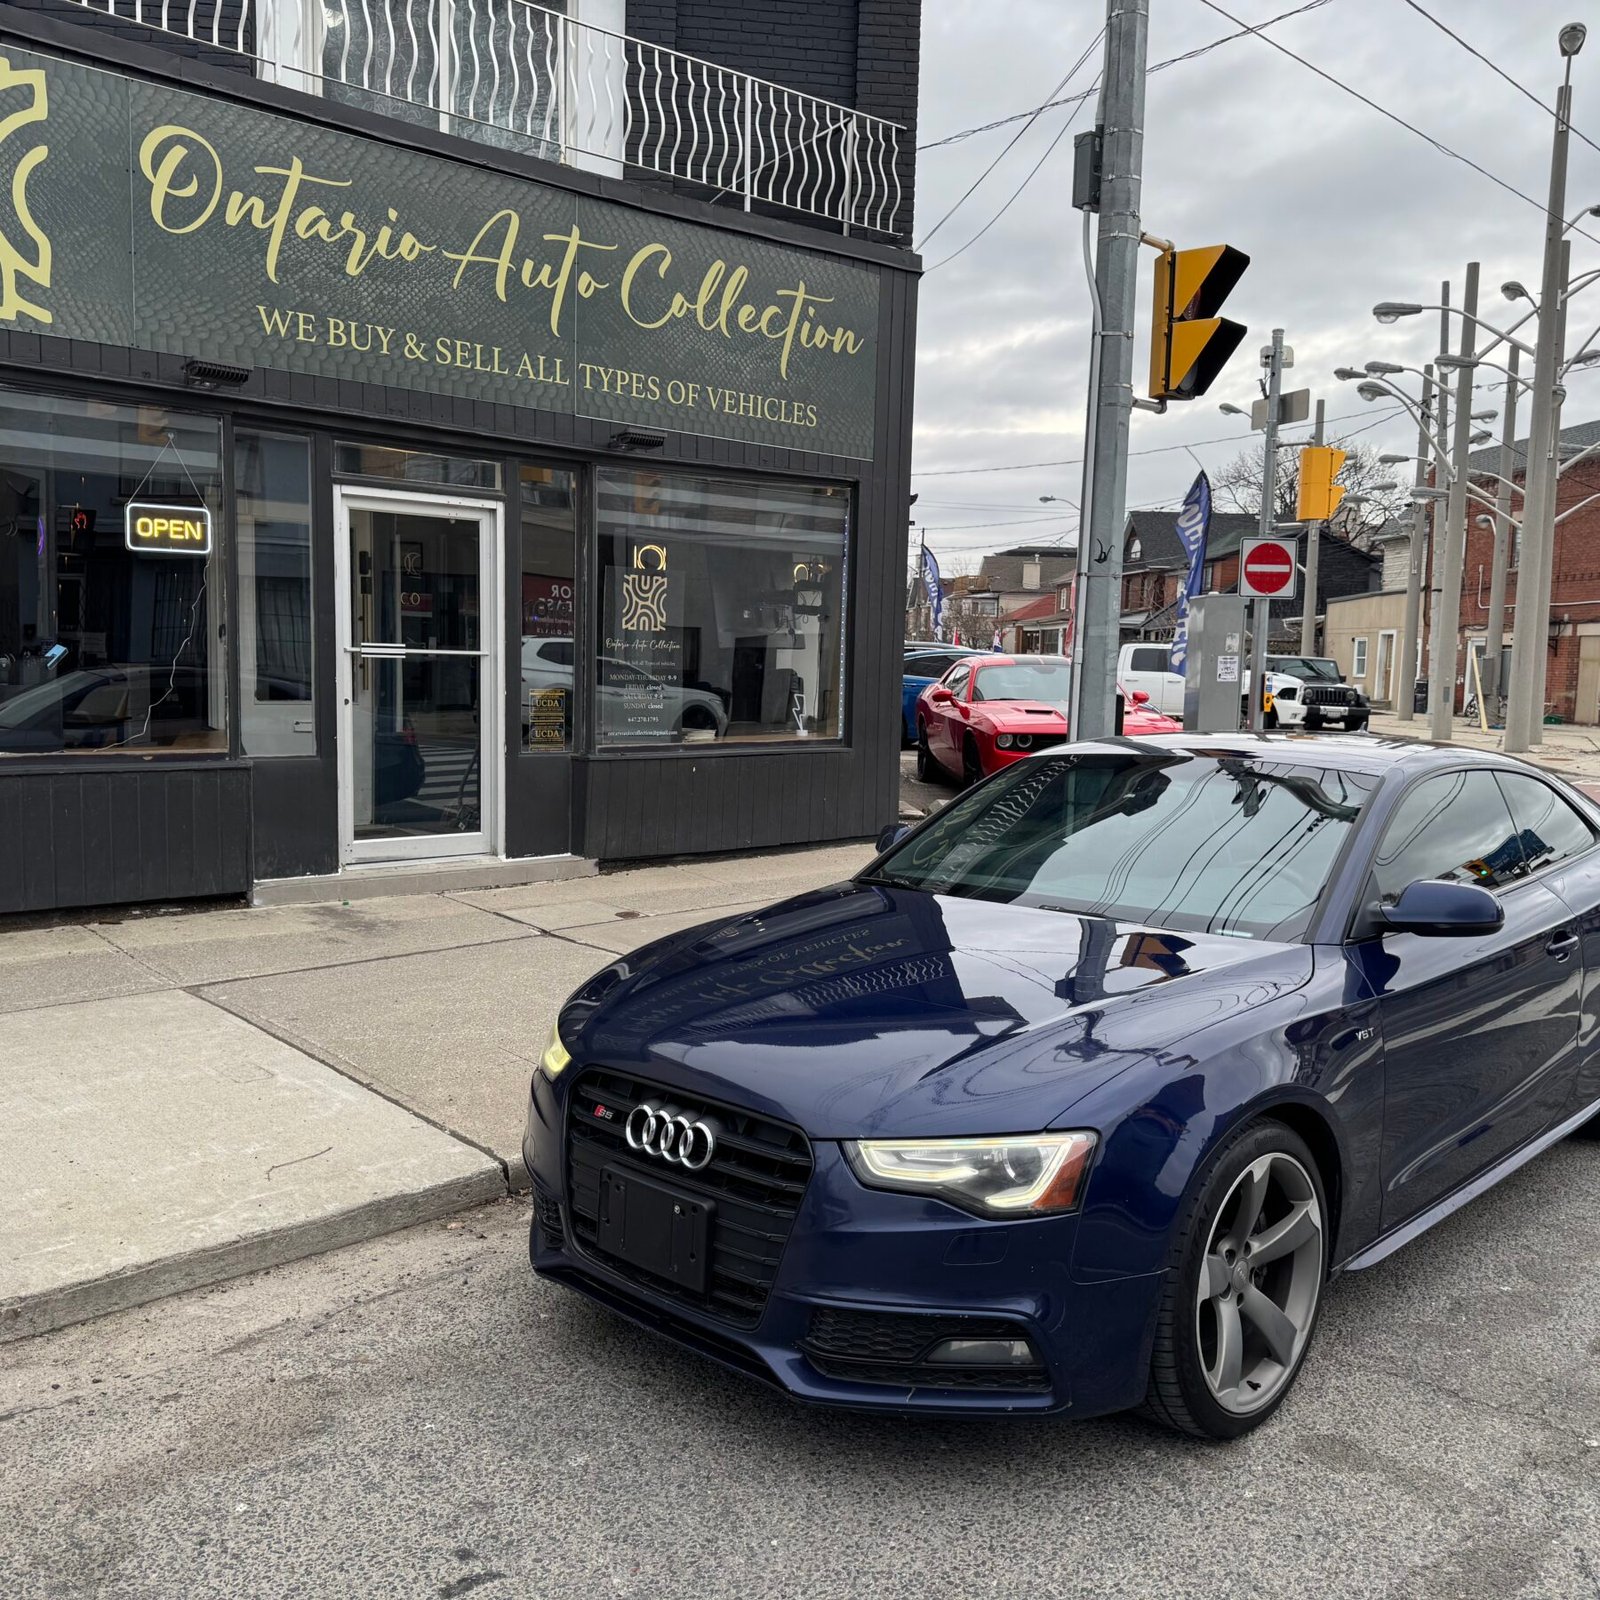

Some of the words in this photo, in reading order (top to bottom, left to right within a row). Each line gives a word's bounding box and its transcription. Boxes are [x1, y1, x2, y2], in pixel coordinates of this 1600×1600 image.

[138, 124, 436, 285] Ontario
[442, 209, 618, 337] Auto
[621, 242, 864, 380] Collection
[256, 305, 317, 343] WE
[326, 317, 396, 356] BUY
[403, 331, 427, 361] &
[435, 338, 509, 376] SELL
[514, 352, 570, 386] ALL
[578, 362, 660, 401] TYPES
[667, 379, 700, 407] OF
[705, 386, 818, 428] VEHICLES
[136, 516, 202, 541] OPEN
[632, 638, 648, 653] Auto
[649, 639, 681, 653] Collection
[646, 683, 662, 691] closed
[535, 699, 559, 707] UCDA
[647, 702, 664, 710] closed
[535, 729, 560, 738] UCDA
[597, 1107, 614, 1120] S5
